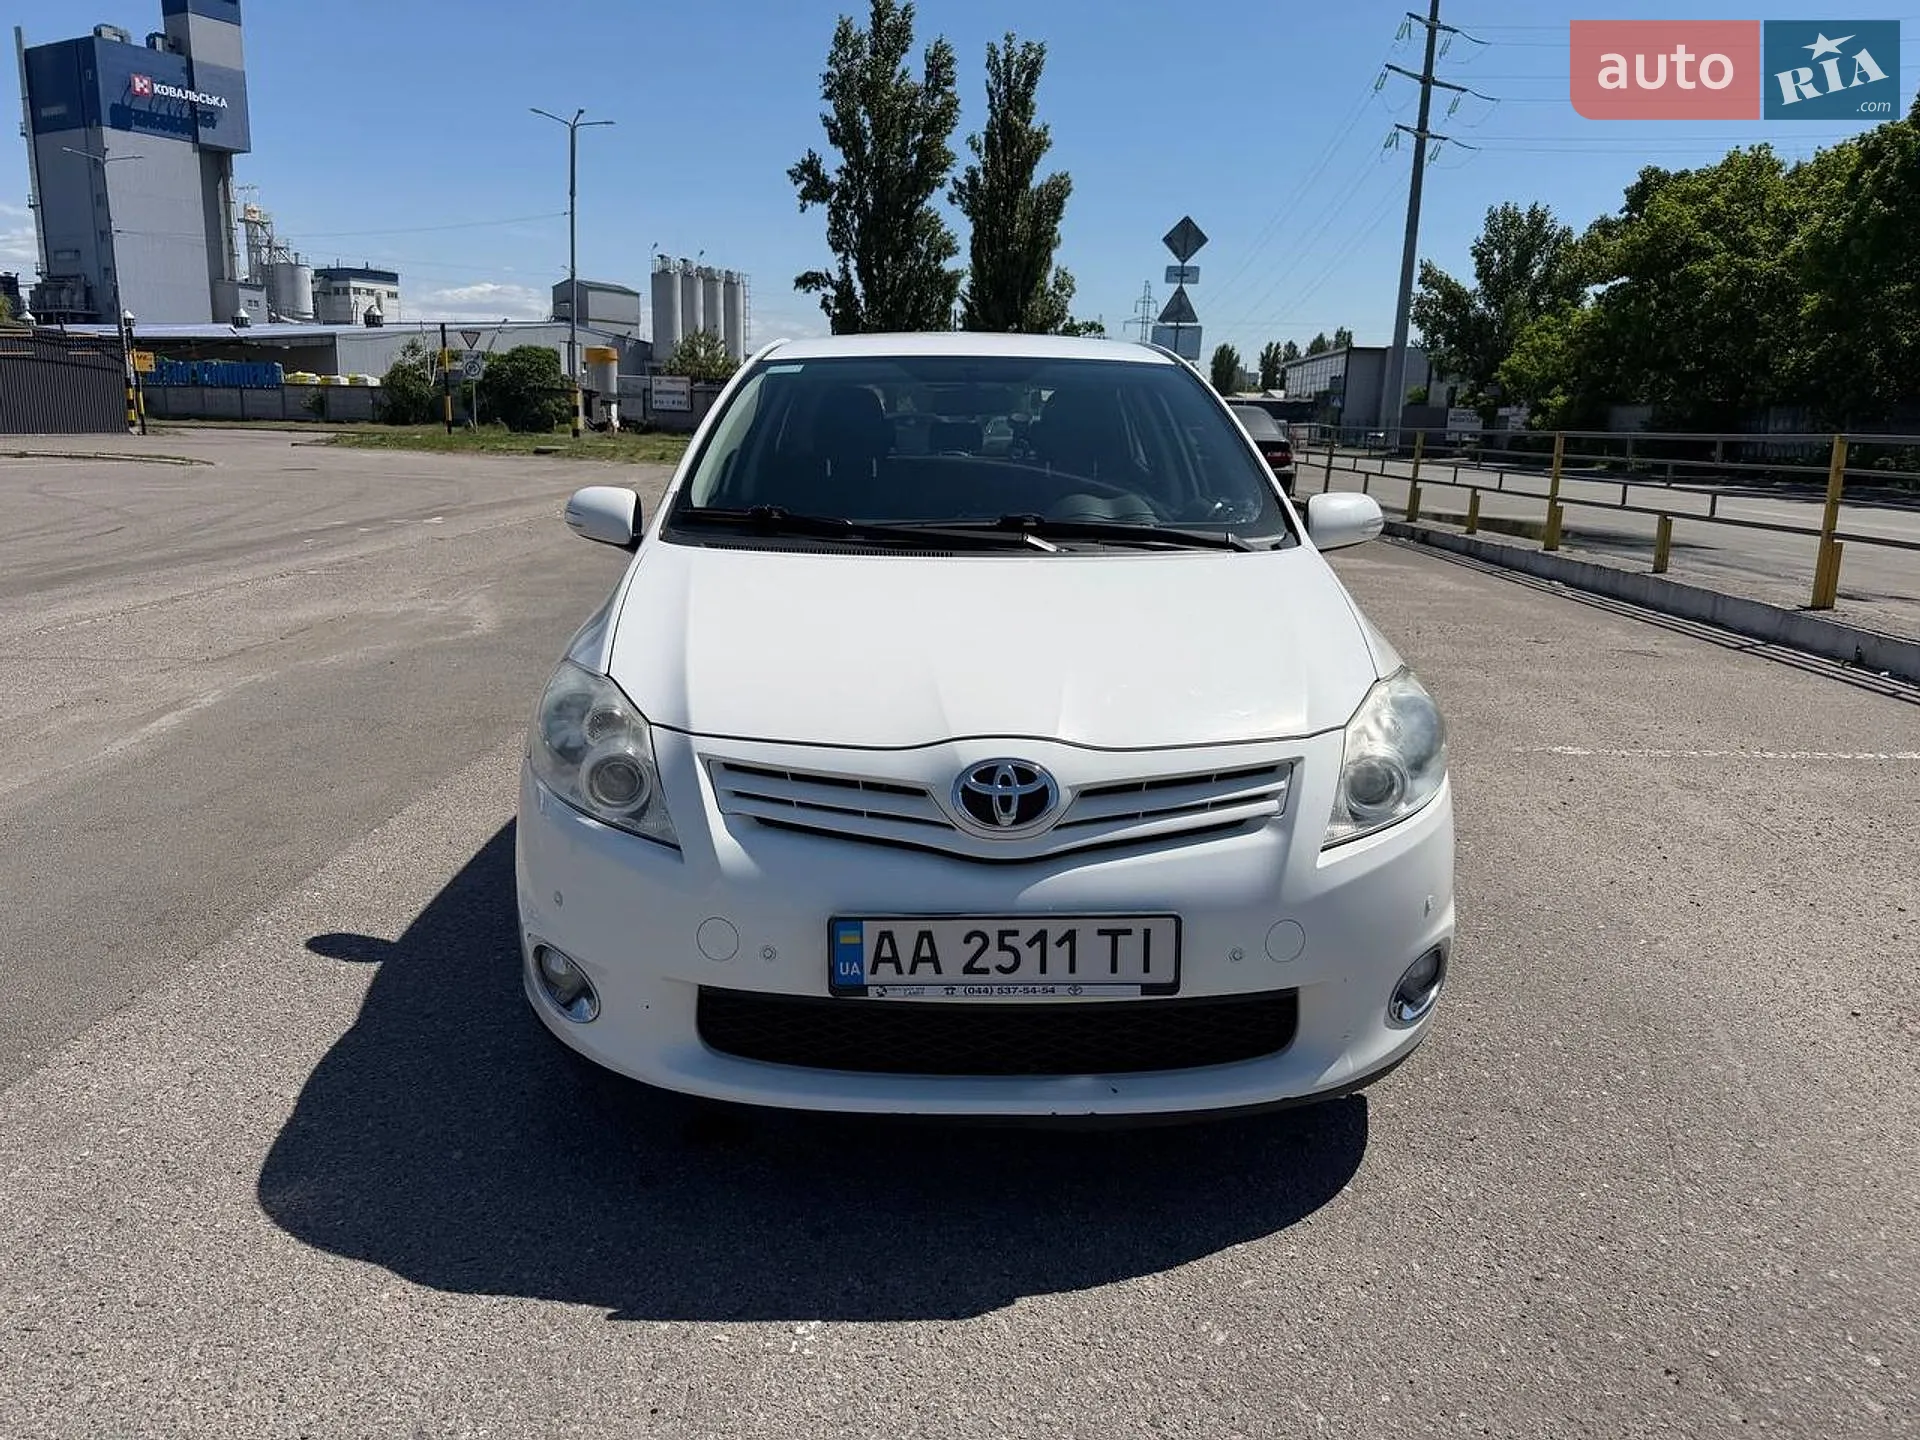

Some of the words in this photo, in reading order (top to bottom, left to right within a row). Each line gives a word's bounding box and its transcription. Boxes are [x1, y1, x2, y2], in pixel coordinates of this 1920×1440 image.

[152, 82, 228, 109] КОВАЛЬСЬКА
[869, 930, 943, 976] AA
[962, 929, 1077, 975] 2511
[1097, 928, 1152, 975] TI
[839, 961, 862, 976] UA
[963, 985, 993, 996] (044)
[996, 985, 1056, 996] 537-54-54
